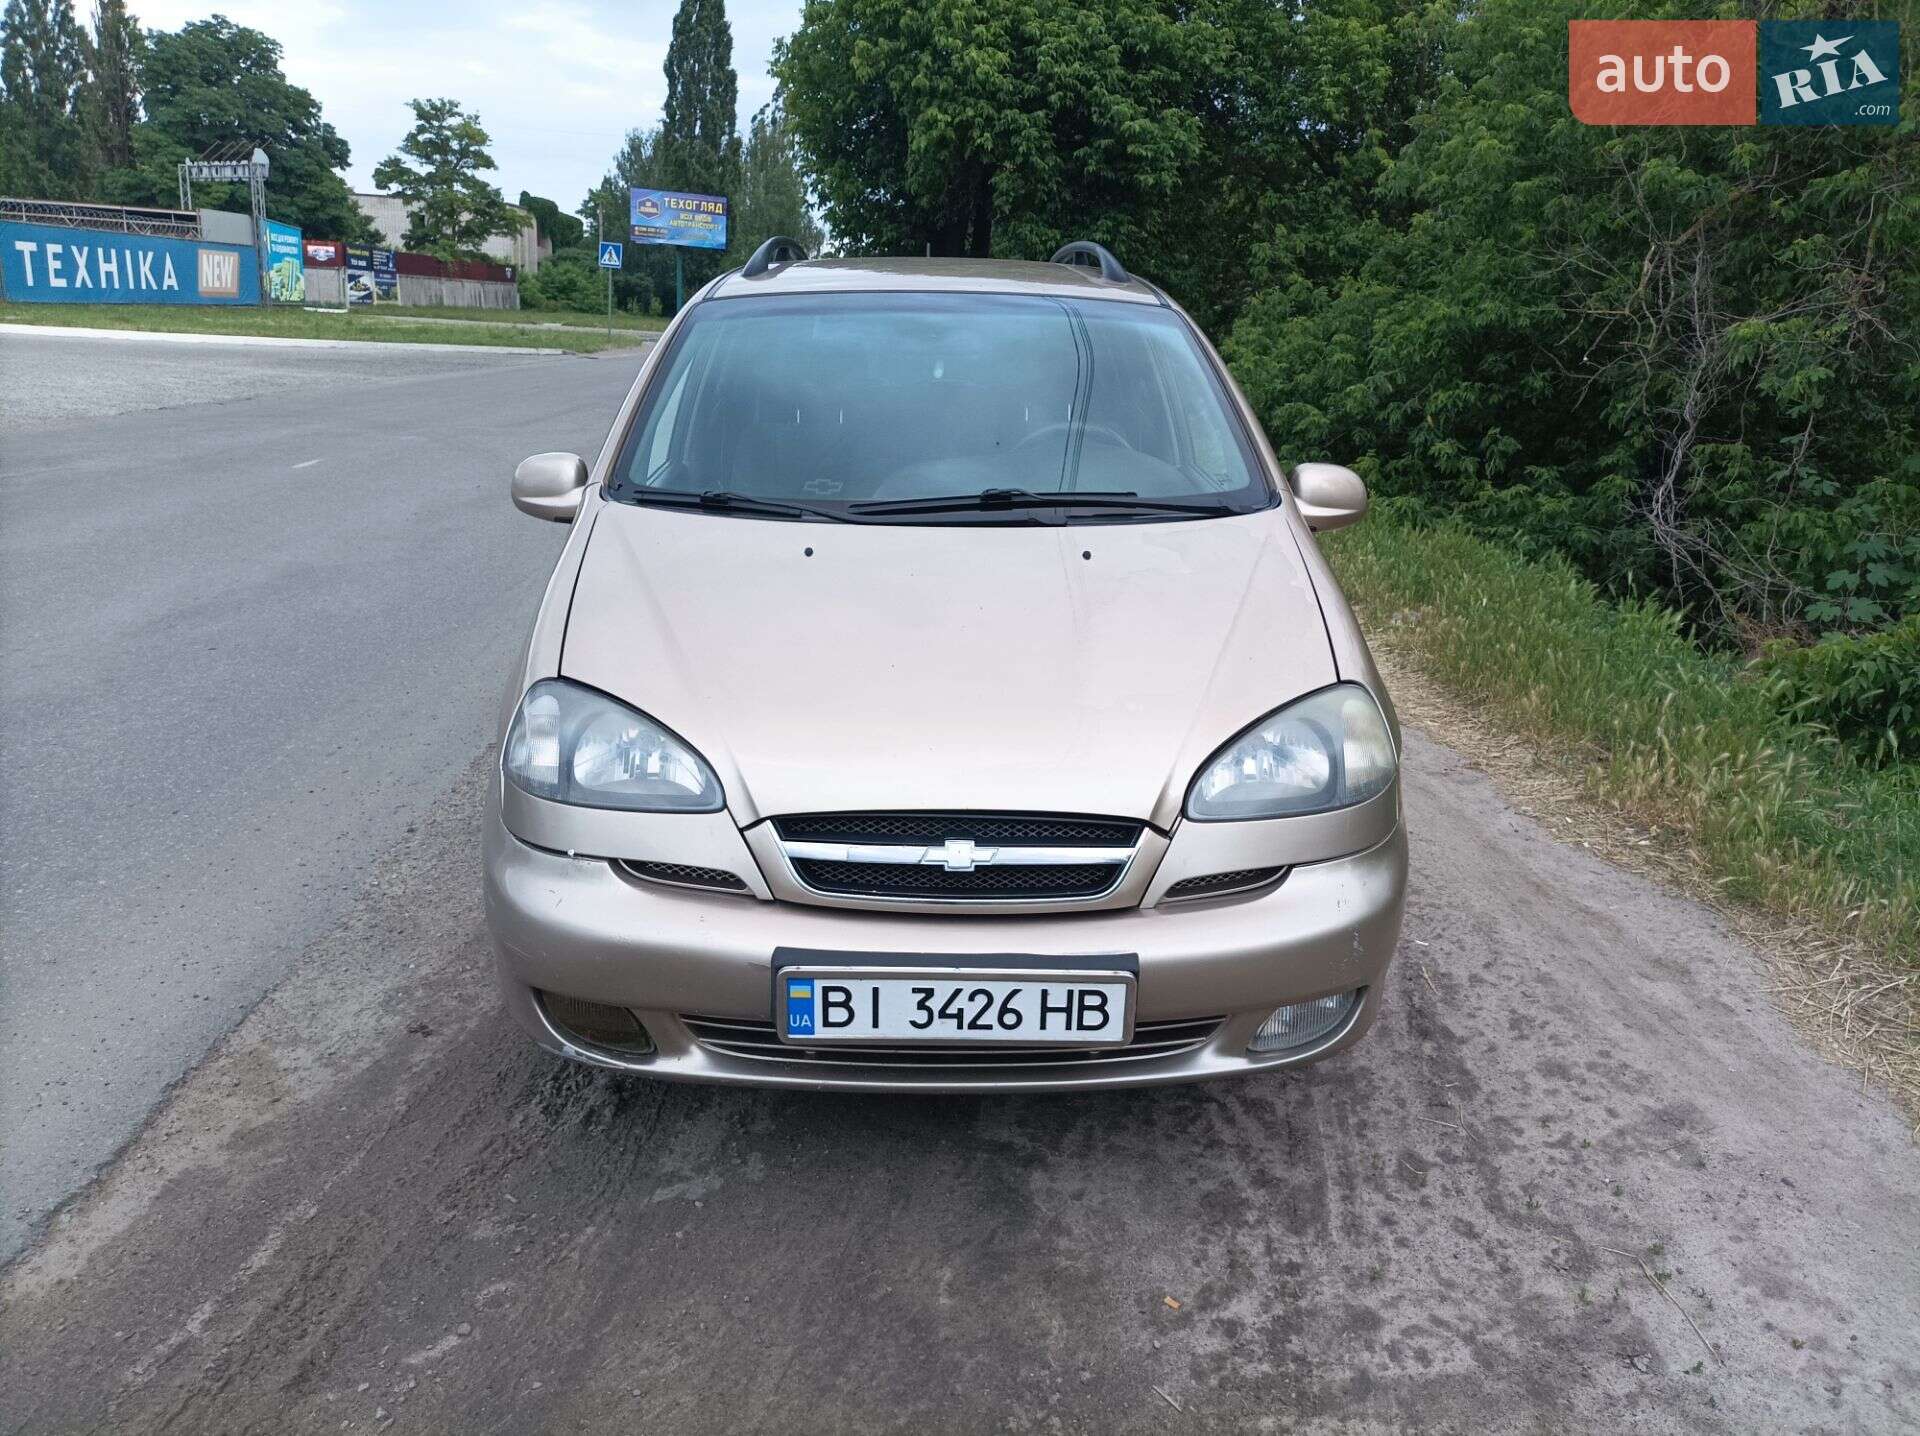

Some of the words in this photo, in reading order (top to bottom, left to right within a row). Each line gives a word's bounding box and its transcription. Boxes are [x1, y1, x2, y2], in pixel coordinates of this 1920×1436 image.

[664, 197, 723, 214] ТЕХОГЛЯД
[14, 240, 180, 291] ТЕХНІКА
[202, 254, 234, 288] NEW
[789, 1014, 811, 1028] UA
[821, 985, 879, 1029] BI
[908, 987, 1024, 1031] 3426
[1040, 988, 1110, 1031] HB
